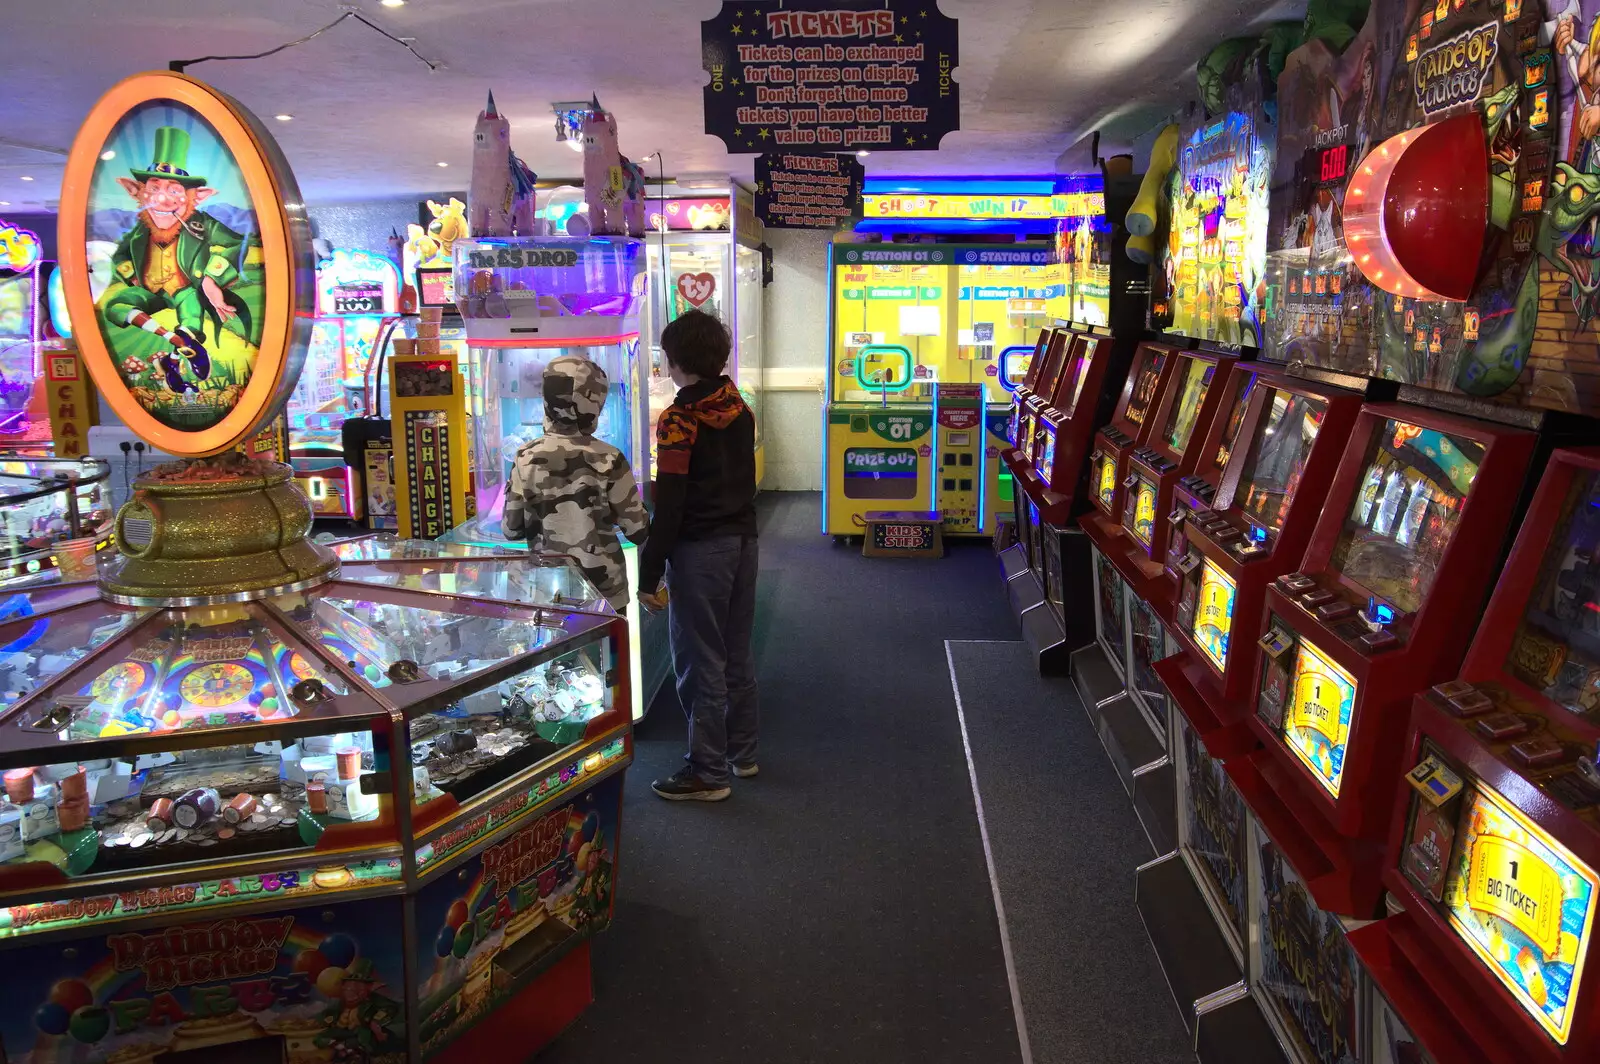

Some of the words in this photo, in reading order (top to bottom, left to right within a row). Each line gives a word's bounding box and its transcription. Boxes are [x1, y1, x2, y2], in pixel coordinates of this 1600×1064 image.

[767, 10, 895, 39] TICKETS
[738, 44, 793, 62] Tickets
[794, 47, 825, 62] can
[825, 44, 845, 62] be
[847, 43, 924, 63] exchanged
[712, 64, 724, 92] ONE
[745, 67, 768, 82] for
[769, 66, 794, 82] the
[796, 66, 840, 86] prizes
[842, 68, 862, 82] on
[864, 65, 919, 84] display.
[939, 52, 950, 98] TICKET
[757, 86, 796, 103] Don't
[798, 85, 841, 105] forget
[843, 86, 869, 102] the
[871, 87, 908, 101] more
[737, 106, 788, 124] tickets
[790, 108, 816, 125] you
[819, 106, 854, 122] have
[856, 105, 882, 122] the
[884, 104, 927, 122] better
[774, 128, 815, 144] value
[817, 127, 841, 143] the
[844, 126, 891, 145] prize!!
[1315, 124, 1349, 145] JACKPOT
[783, 156, 838, 172] TICKETS
[1322, 145, 1347, 181] 600
[1524, 180, 1542, 197] POT
[969, 199, 1005, 216] WIN
[1011, 198, 1027, 212] IT
[1514, 220, 1534, 242] 200
[469, 252, 495, 268] The
[497, 250, 523, 269] £5
[527, 250, 578, 268] DROP
[862, 251, 912, 262] STATION
[914, 251, 928, 262] 01
[980, 252, 1031, 262] STATION
[1032, 252, 1048, 262] 02
[680, 276, 711, 300] ty
[1464, 311, 1480, 332] 10
[890, 424, 911, 439] 01
[847, 452, 885, 466] PRIZE
[887, 453, 917, 466] OUT
[421, 428, 438, 536] CHANGE
[884, 525, 923, 537] KIDS
[884, 537, 924, 548] STEP
[1315, 685, 1321, 699] 1
[1303, 701, 1313, 715] BIG
[1313, 703, 1329, 722] TICKET
[1509, 861, 1518, 881] 1
[1487, 878, 1503, 898] BIG
[1505, 884, 1537, 920] TICKET
